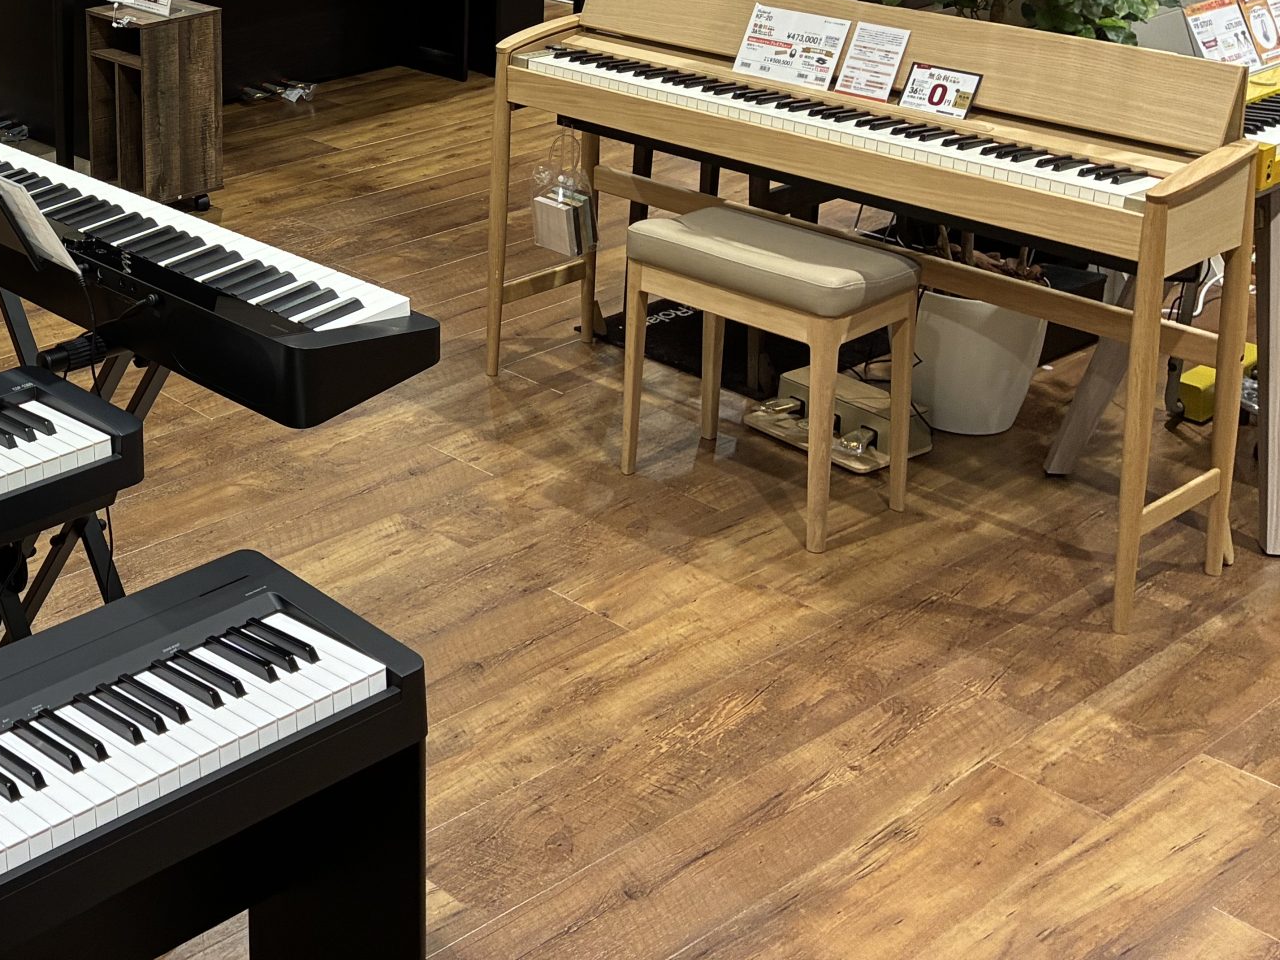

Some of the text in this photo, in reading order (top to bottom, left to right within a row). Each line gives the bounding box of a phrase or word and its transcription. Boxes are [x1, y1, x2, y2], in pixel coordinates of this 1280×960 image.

[755, 13, 773, 22] KF-20
[787, 31, 819, 45] ¥473,000
[646, 306, 694, 327] Rola
